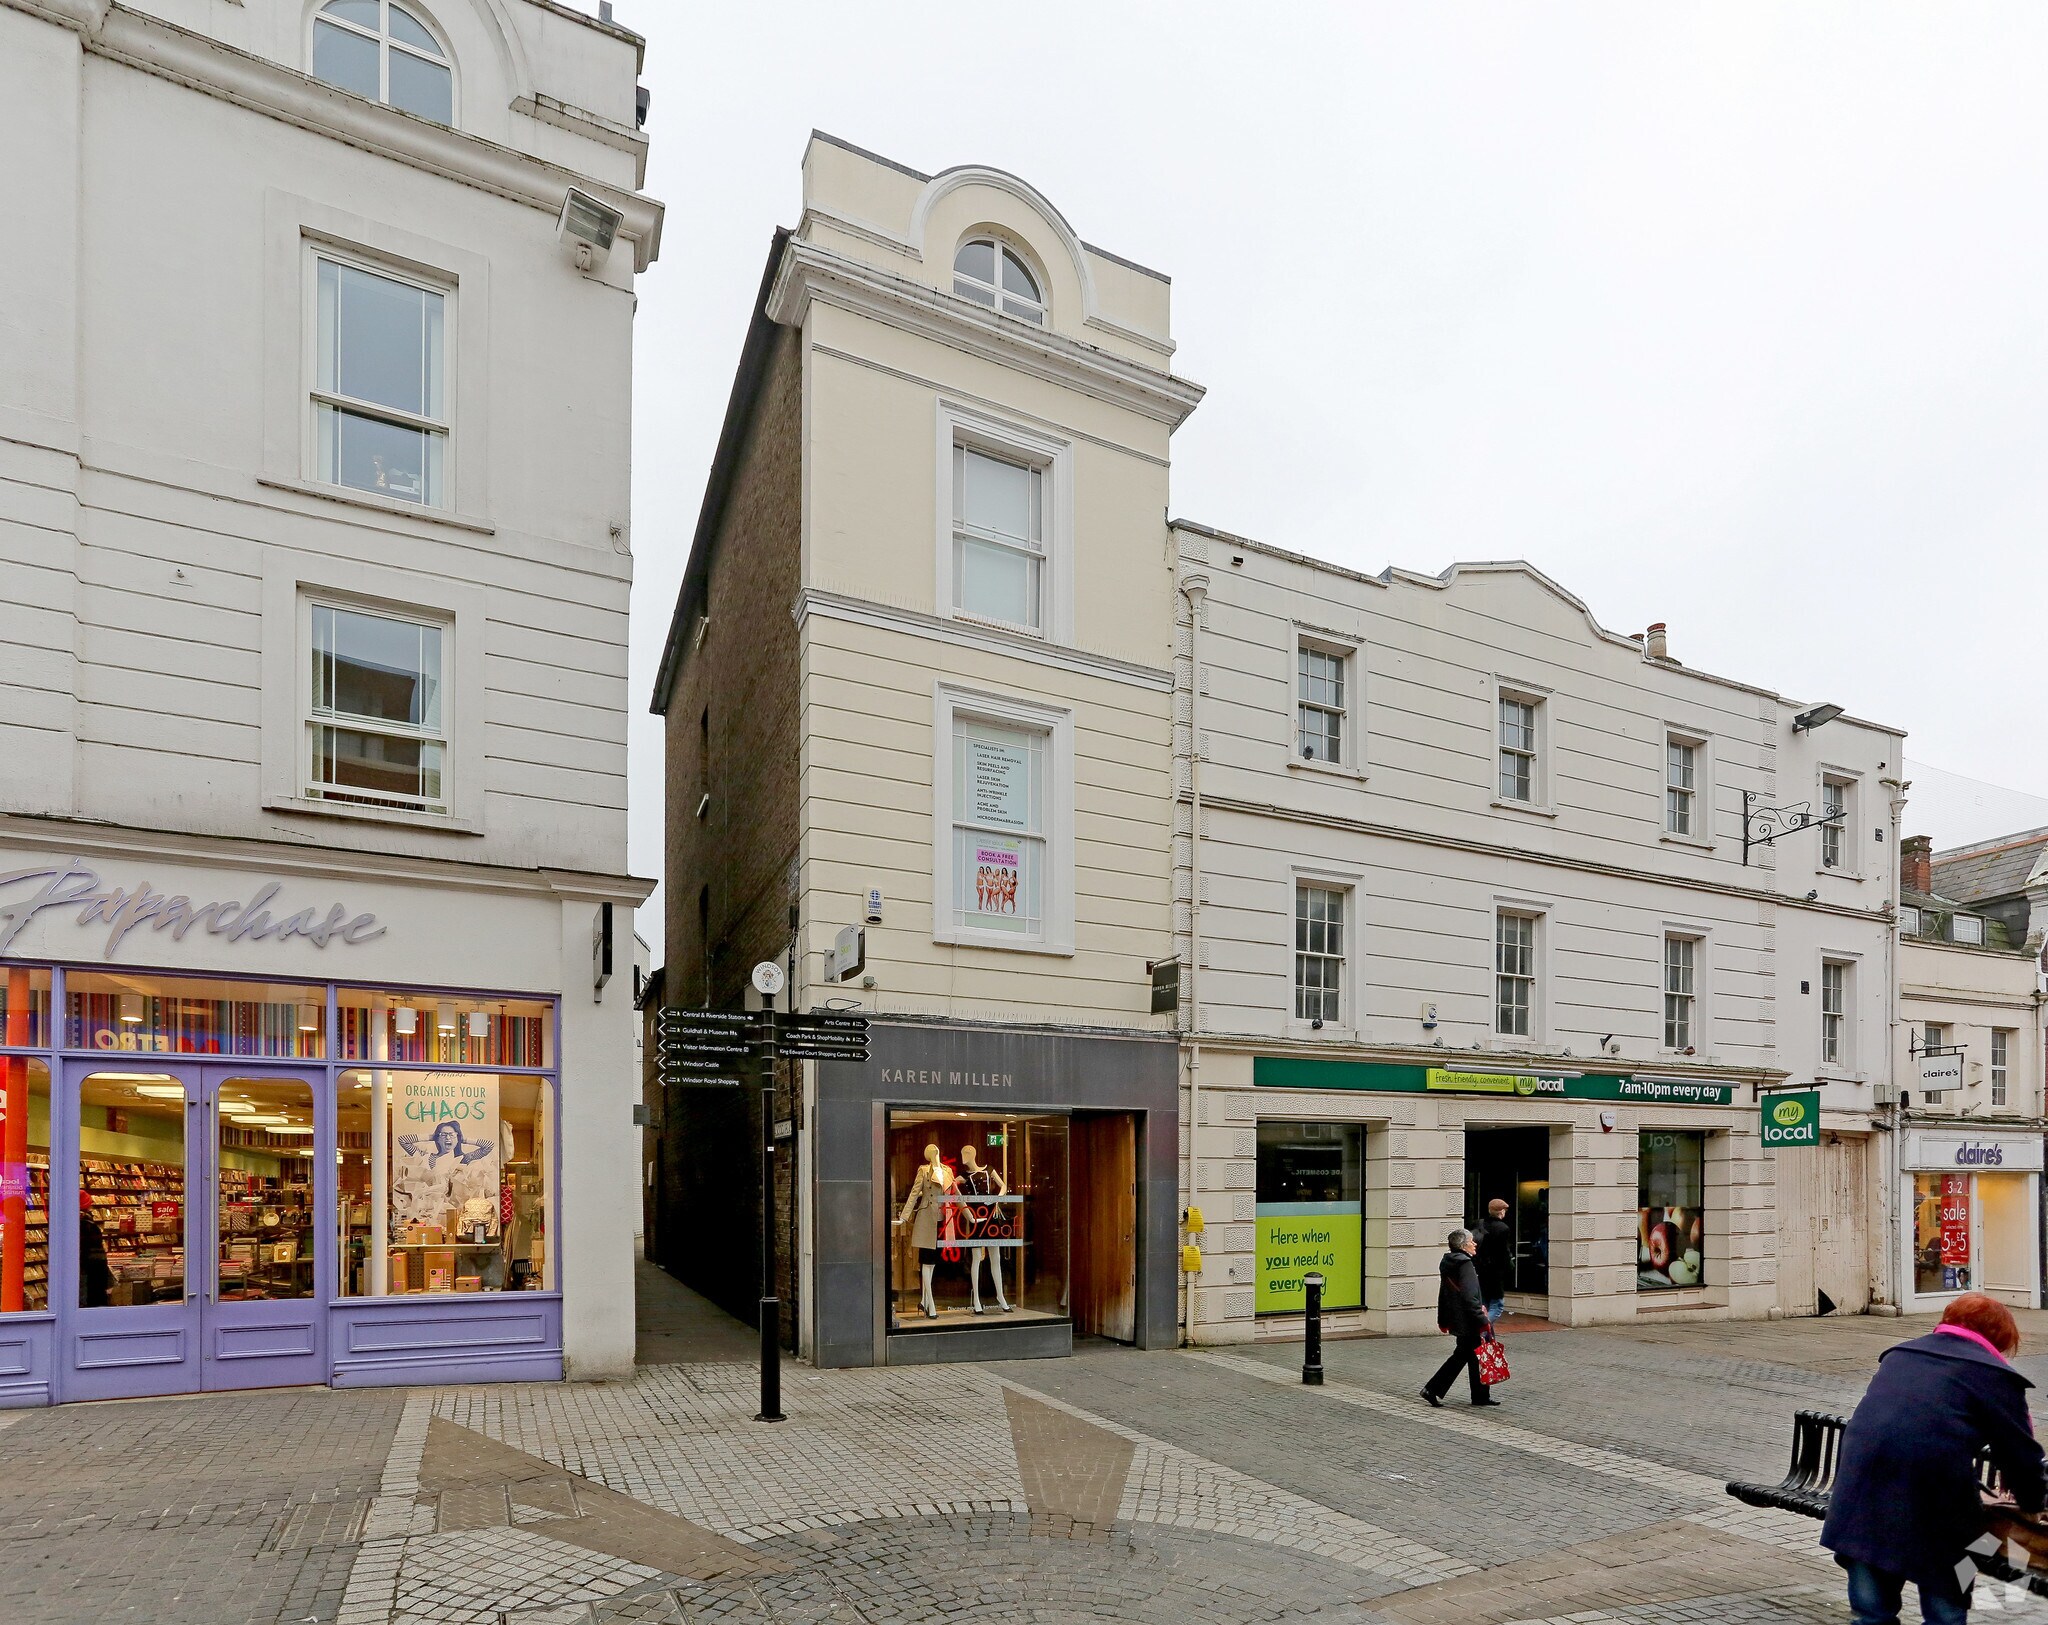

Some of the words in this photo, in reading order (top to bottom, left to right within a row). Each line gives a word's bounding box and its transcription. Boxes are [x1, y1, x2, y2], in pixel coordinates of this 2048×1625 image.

[978, 855, 1017, 866] CONSULTATION
[0, 857, 388, 959] Paperchase
[755, 963, 781, 976] WINDSOR
[727, 1013, 746, 1021] Stations
[816, 1034, 845, 1042] ShopMobility
[779, 1048, 789, 1056] King
[817, 1050, 837, 1058] Shopping
[881, 1068, 941, 1084] KAREN
[949, 1071, 1012, 1087] MILLEN
[1922, 1068, 1959, 1078] claire's
[703, 1077, 717, 1085] Royal
[717, 1078, 740, 1086] Shopping
[1519, 1077, 1534, 1091] my
[1536, 1076, 1565, 1092] local
[405, 1085, 456, 1097] ORGANISE
[460, 1086, 486, 1098] YOUR
[1673, 1085, 1701, 1100] every
[1703, 1086, 1721, 1101] day
[405, 1100, 486, 1122] CHAOS
[1779, 1106, 1799, 1122] my
[1764, 1123, 1814, 1141] local
[1956, 1141, 2003, 1165] claire's
[1947, 1181, 1953, 1194] 3
[1957, 1181, 1963, 1194] 2
[157, 1205, 174, 1213] sale
[1943, 1199, 1967, 1221] sale
[1270, 1228, 1298, 1245] Here
[1301, 1228, 1330, 1243] when
[1942, 1232, 1950, 1252] 5
[1956, 1231, 1967, 1252] £5
[1265, 1256, 1290, 1271] you
[1293, 1250, 1319, 1267] need
[1322, 1253, 1334, 1266] us
[1269, 1278, 1305, 1292] every
